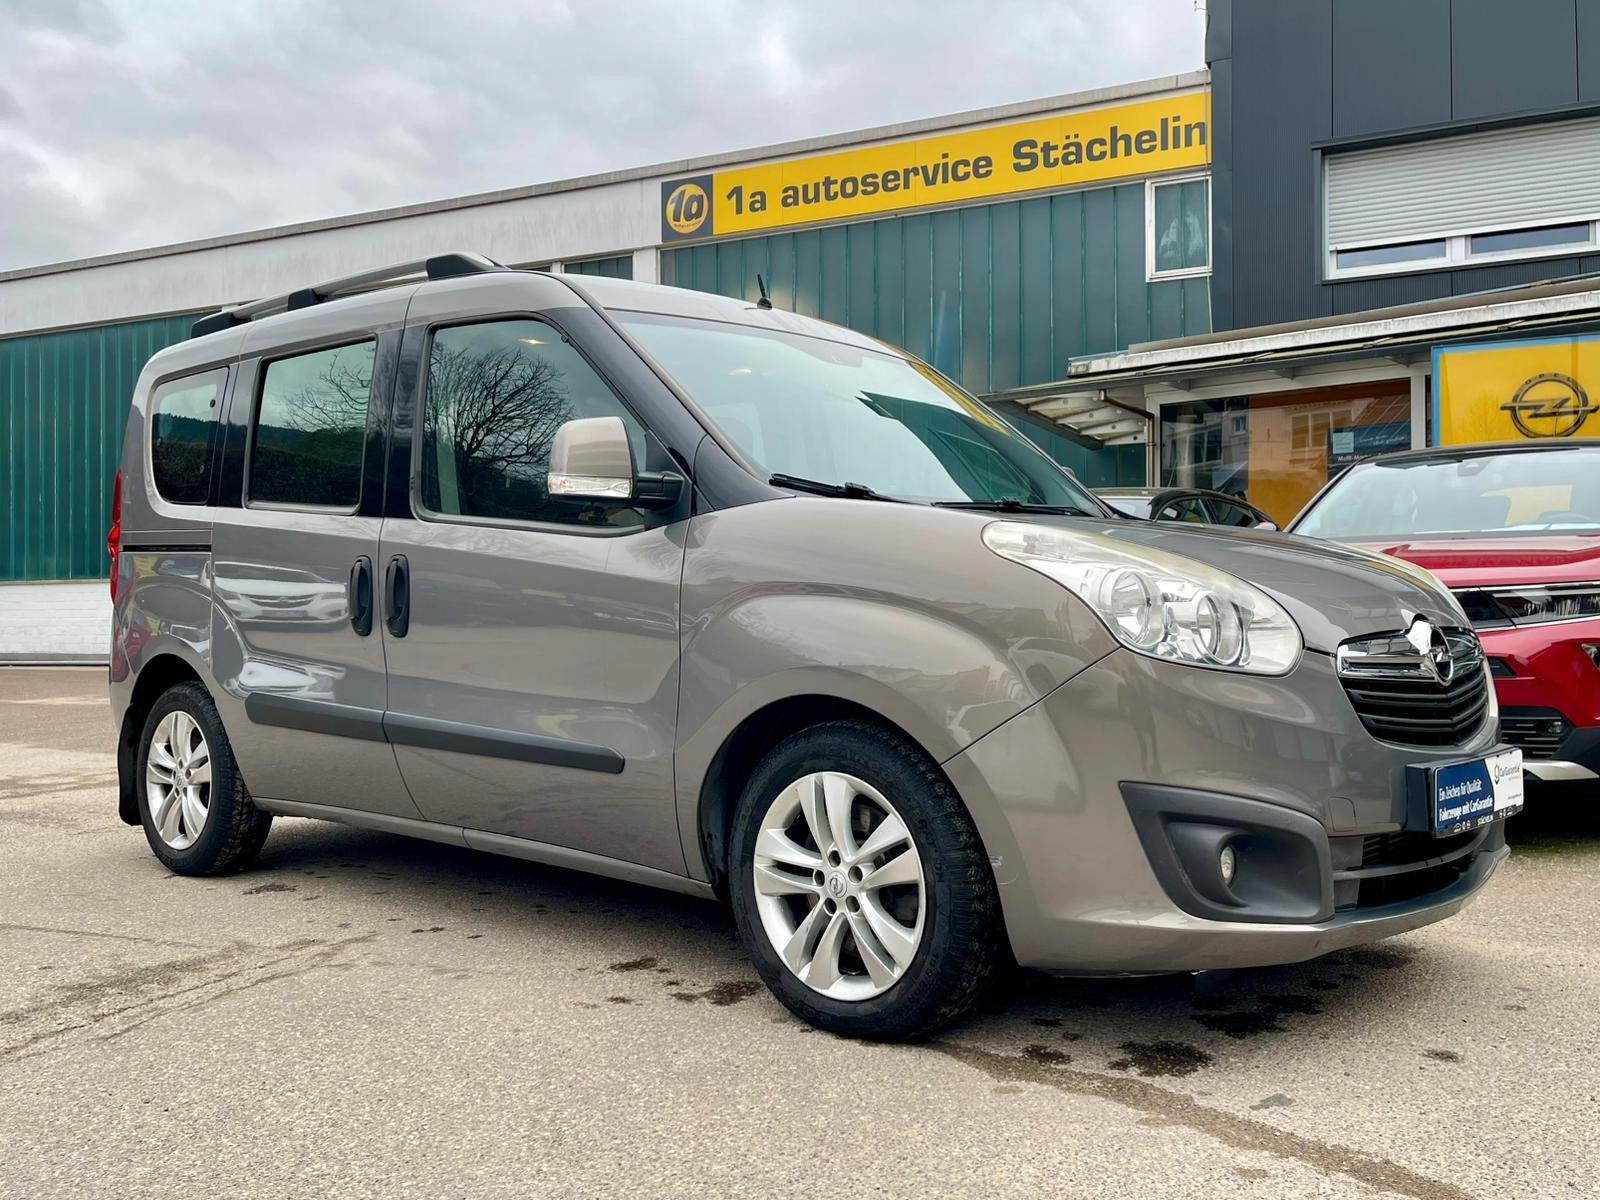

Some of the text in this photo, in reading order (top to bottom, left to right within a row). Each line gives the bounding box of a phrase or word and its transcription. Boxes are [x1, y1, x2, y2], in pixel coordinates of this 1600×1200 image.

[726, 115, 1207, 215] 1a autoservice Stächelin
